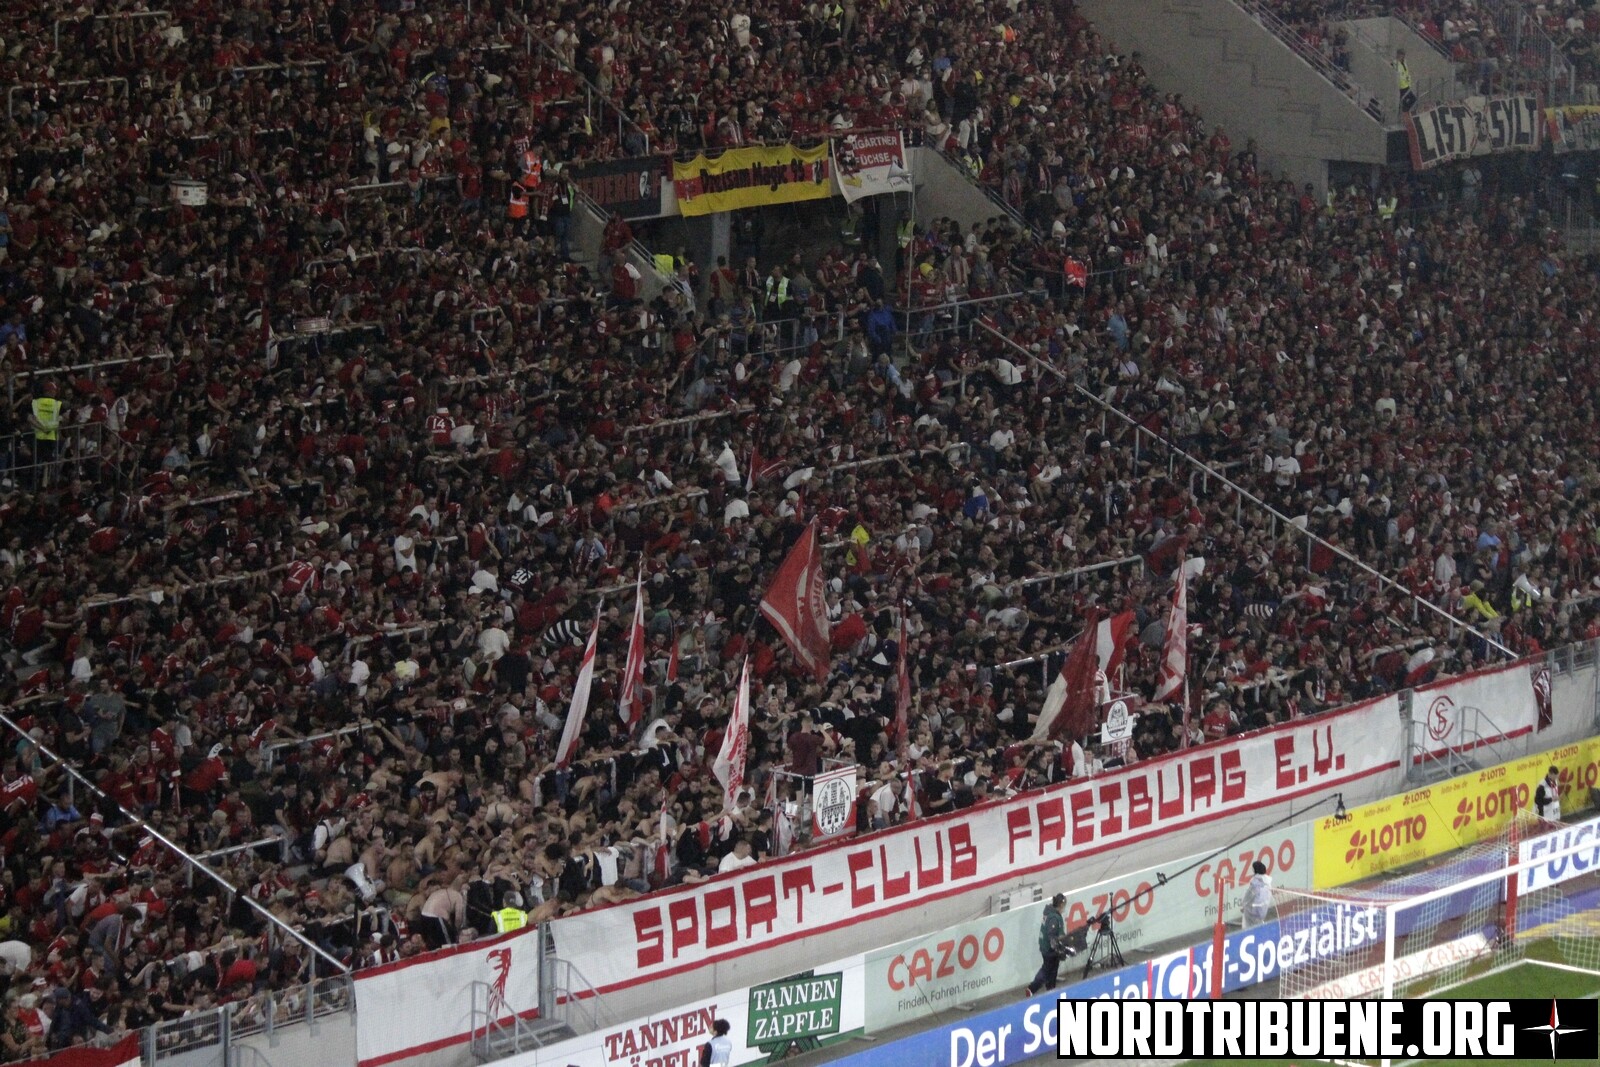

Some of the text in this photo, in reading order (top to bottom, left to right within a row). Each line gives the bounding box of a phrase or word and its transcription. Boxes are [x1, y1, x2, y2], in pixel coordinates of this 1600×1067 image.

[1413, 106, 1466, 162] LIST
[1489, 98, 1537, 149] SYLT
[432, 418, 446, 430] 14
[1559, 745, 1579, 759] LOTTO
[1487, 767, 1506, 780] LOTTO
[1410, 789, 1431, 803] LOTTO
[1476, 782, 1530, 822] LOTTO
[1370, 814, 1427, 855] LOTTO
[632, 822, 978, 969] SPORT-CLUB
[1006, 749, 1246, 864] FREIBURG
[1194, 838, 1296, 898] CAZOO
[1066, 881, 1155, 936] AZOO
[887, 926, 1006, 992] CAZOO
[753, 978, 838, 1011] TANNEN
[963, 974, 994, 993] Freuen.
[604, 1004, 718, 1063] TANNEN
[754, 1008, 834, 1041] ZÄPFLE
[950, 1022, 1012, 1067] Der
